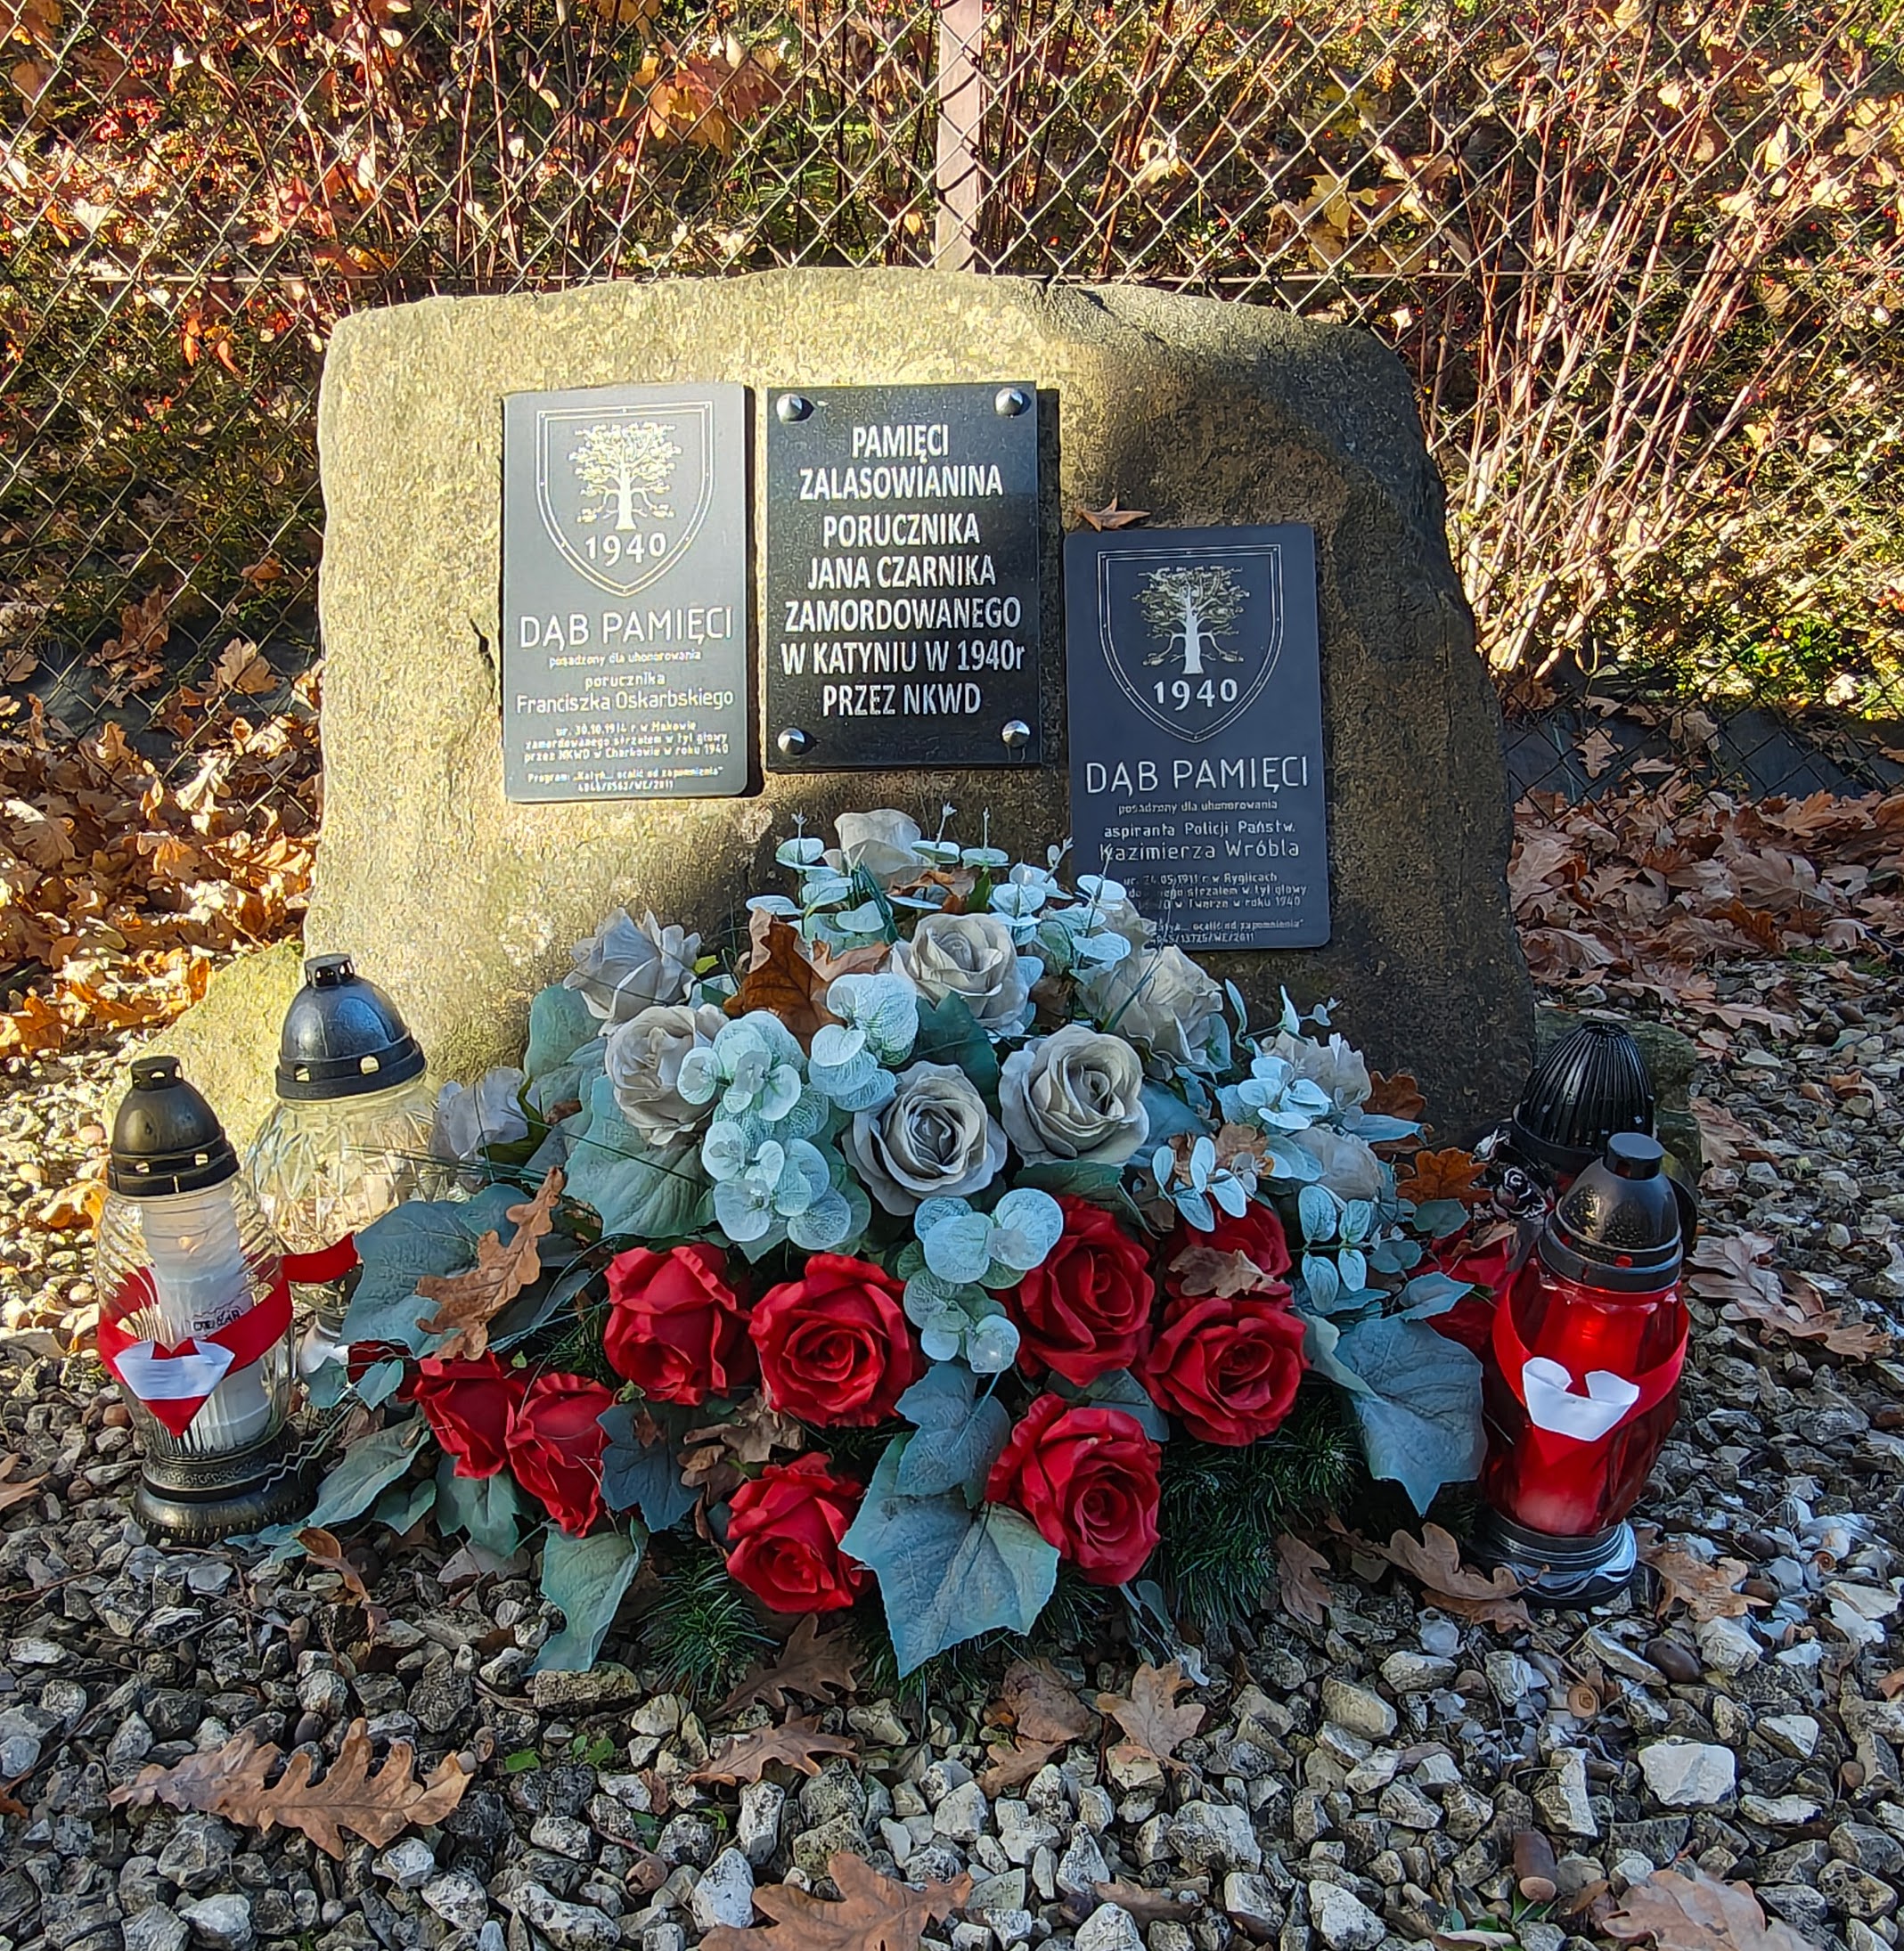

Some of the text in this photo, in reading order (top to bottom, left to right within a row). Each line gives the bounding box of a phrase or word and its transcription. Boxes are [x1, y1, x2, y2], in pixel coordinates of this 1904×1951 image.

[852, 424, 949, 463] PAMIĘCI
[799, 465, 1003, 501] ZALASOWIANINA
[823, 513, 981, 549] PORUCZNIKA
[584, 533, 666, 567] 1940
[807, 554, 996, 591] JANA CZARNIKA
[520, 606, 732, 651] DĄB PAMIĘCI
[785, 597, 1021, 633] ZAMORDOWANEGO
[549, 649, 702, 670] posadzony dla uhonorowania
[780, 640, 1026, 676] W KATYNIU W 1940r
[584, 670, 666, 691] porucznika
[1153, 678, 1238, 712] 1940
[516, 687, 734, 714] Franciszka Oskarbskiego
[822, 683, 981, 717] PRZEZ NKWD
[525, 738, 610, 750] zamordowanego
[666, 735, 674, 744] w
[555, 728, 572, 737] ur.
[641, 724, 649, 732] w
[651, 721, 697, 732] Makowie
[524, 743, 729, 765] przez NKWD w Charkowie w roku 1940
[1086, 756, 1308, 798] DĄB PAMIĘCI
[1118, 799, 1278, 816] posadzony dla uhonorowania
[1104, 819, 1295, 840] aspiranta Policji Państw.
[1099, 840, 1300, 861] Kazimierza Wróbla
[1212, 875, 1220, 883] w
[1224, 872, 1278, 886] Ryglicach
[1245, 896, 1271, 908] roku
[1275, 895, 1301, 908] 1940
